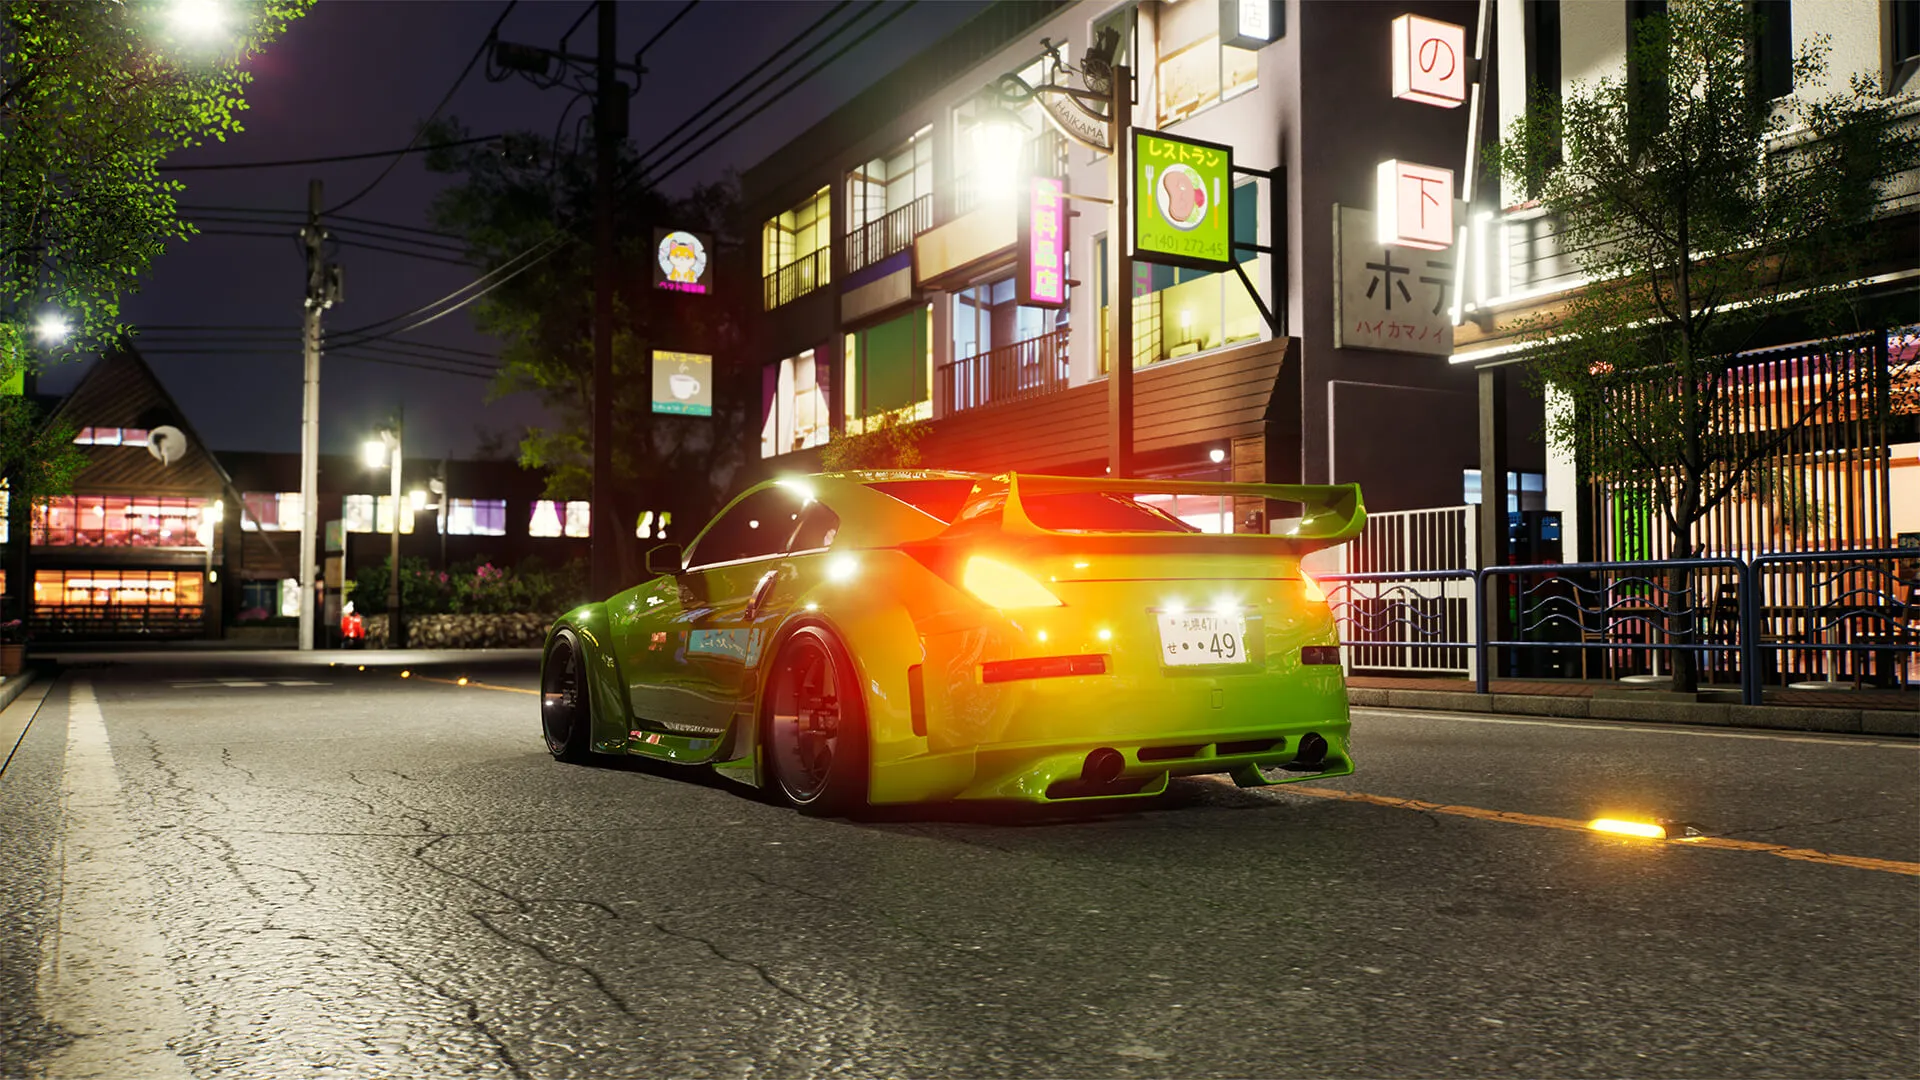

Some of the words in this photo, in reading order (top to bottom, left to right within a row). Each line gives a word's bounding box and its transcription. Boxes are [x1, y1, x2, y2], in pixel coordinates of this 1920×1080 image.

[1420, 38, 1455, 81] の
[1055, 101, 1104, 140] HAIKAMA
[1149, 139, 1219, 168] レストラン
[1402, 174, 1444, 229] 下
